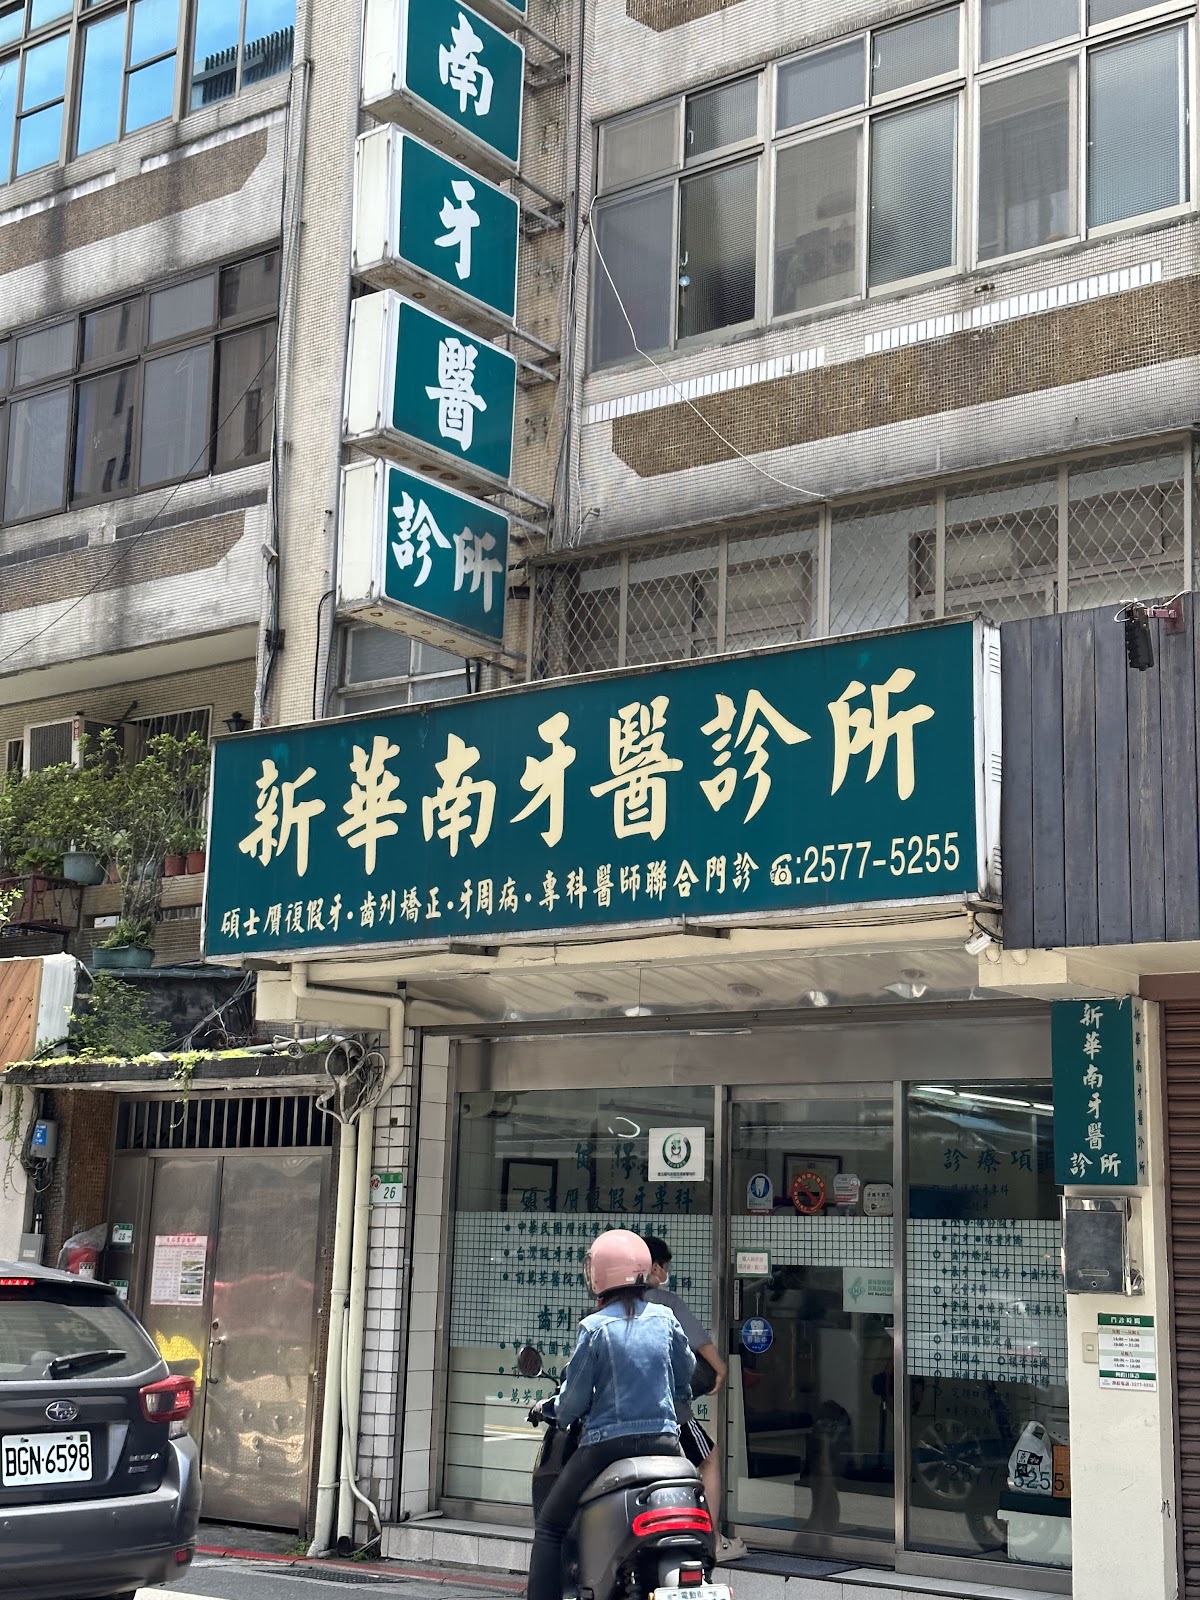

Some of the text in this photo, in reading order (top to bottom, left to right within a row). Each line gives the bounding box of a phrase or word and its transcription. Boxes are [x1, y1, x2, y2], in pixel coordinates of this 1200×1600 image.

[391, 491, 504, 613] 診所
[238, 667, 935, 877] 新華南牙醫診所
[1133, 1006, 1146, 1176] 新華南牙醫診所
[575, 1142, 648, 1182] 健保
[1069, 1152, 1122, 1179] 診所
[383, 1187, 397, 1199] 26
[538, 1304, 585, 1332] 齒列
